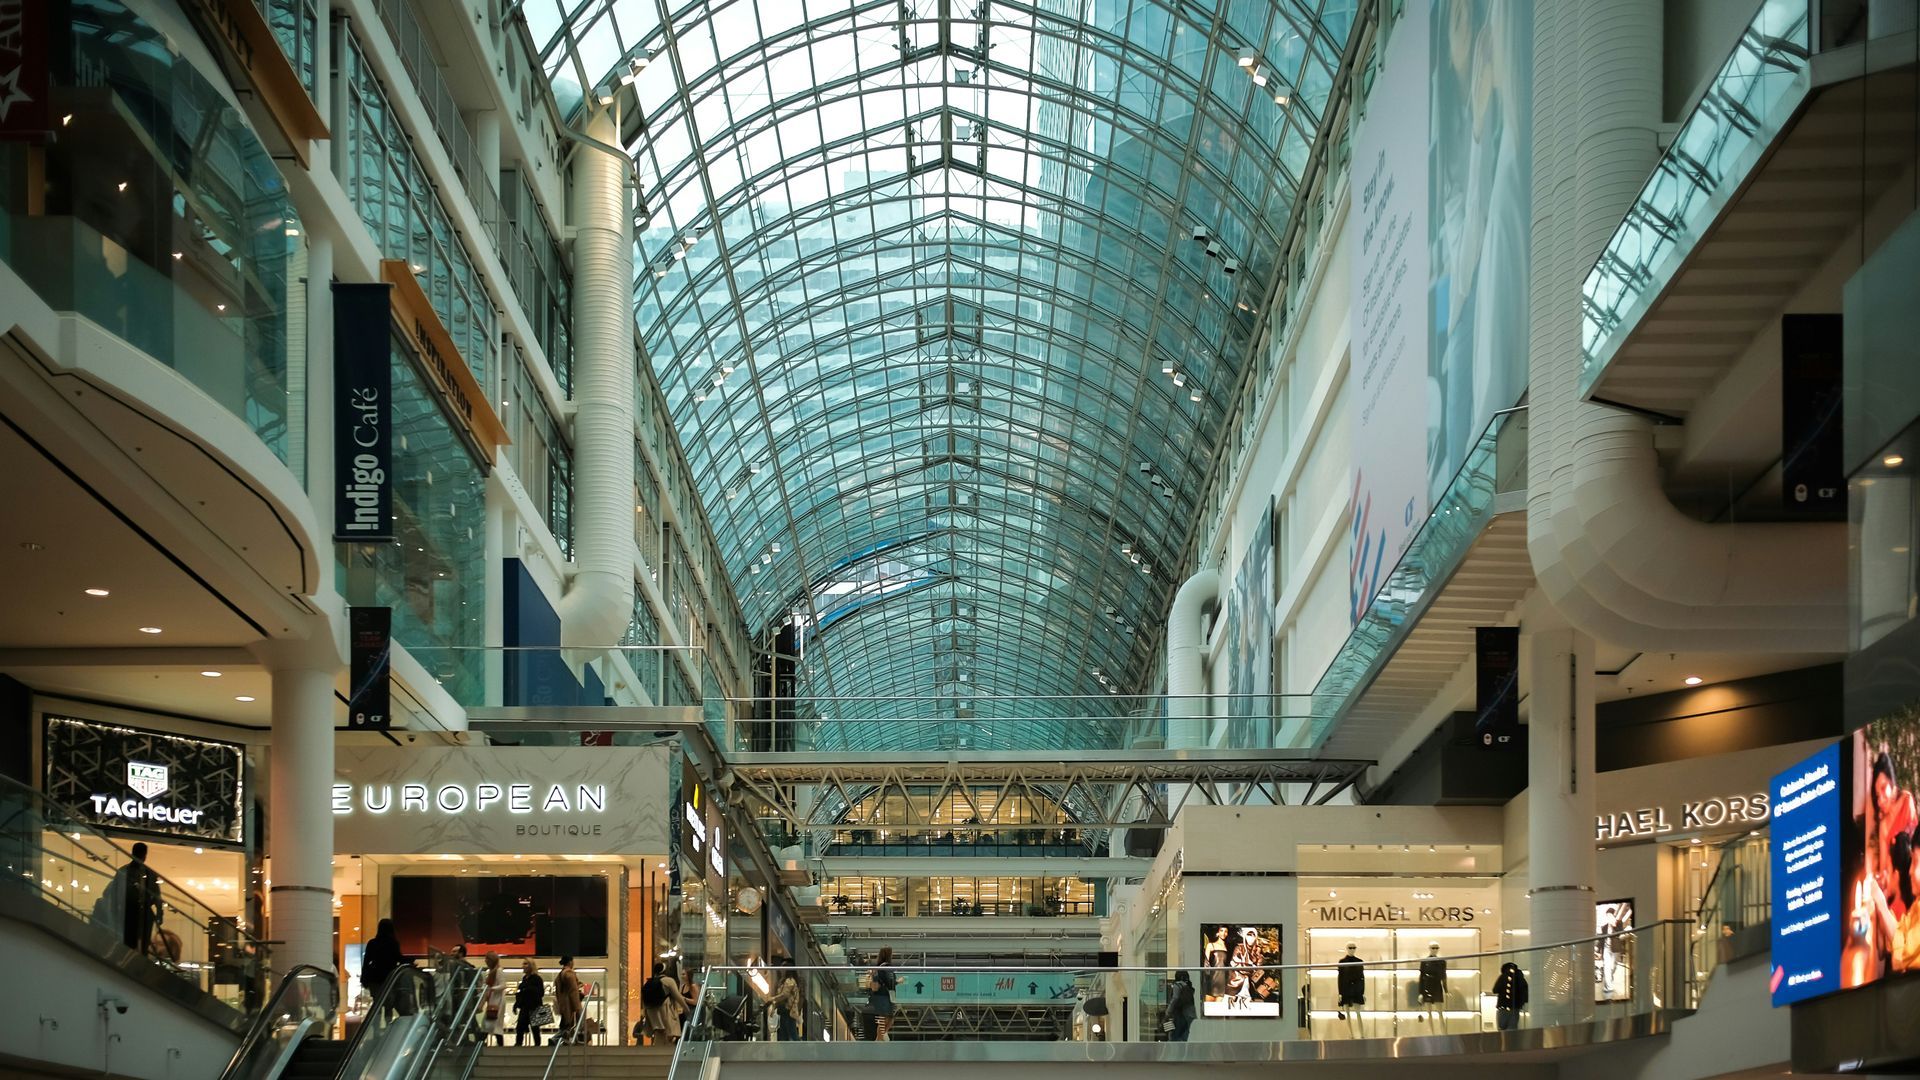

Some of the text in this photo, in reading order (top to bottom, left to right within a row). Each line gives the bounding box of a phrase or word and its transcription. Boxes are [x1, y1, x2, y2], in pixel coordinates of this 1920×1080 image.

[1363, 221, 1373, 256] the
[416, 318, 472, 422] INSPIRATION
[351, 387, 379, 448] Café
[331, 785, 604, 813] EUROPEAN
[1681, 793, 1770, 830] KORS
[516, 824, 603, 837] BOUTIQUE
[1320, 905, 1475, 922] MICHAEL KORS
